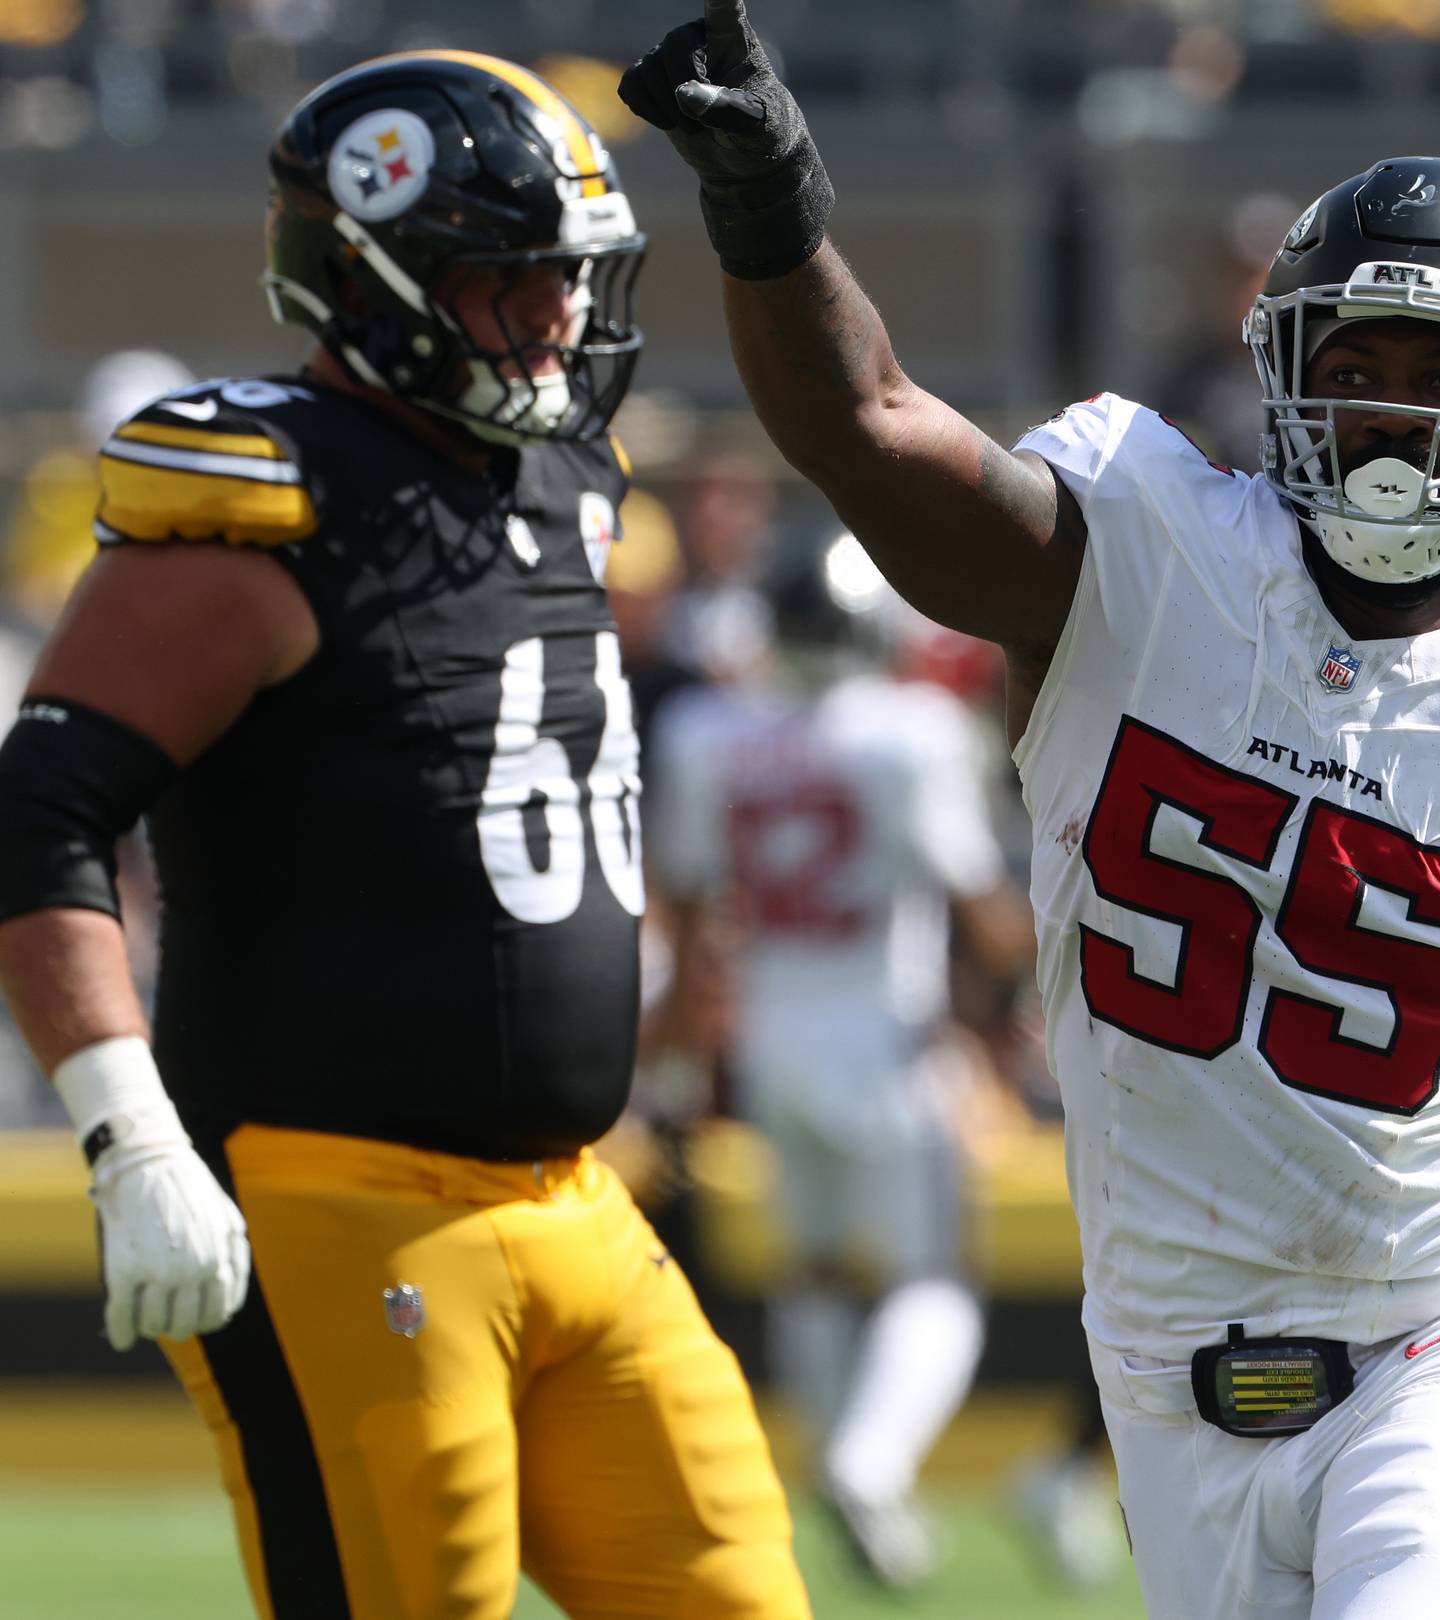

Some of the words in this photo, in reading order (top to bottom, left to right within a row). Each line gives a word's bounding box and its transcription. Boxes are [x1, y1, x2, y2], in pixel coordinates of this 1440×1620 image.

[1373, 264, 1434, 289] ATL
[1322, 659, 1352, 687] NFL
[1246, 736, 1382, 801] ATLANTA
